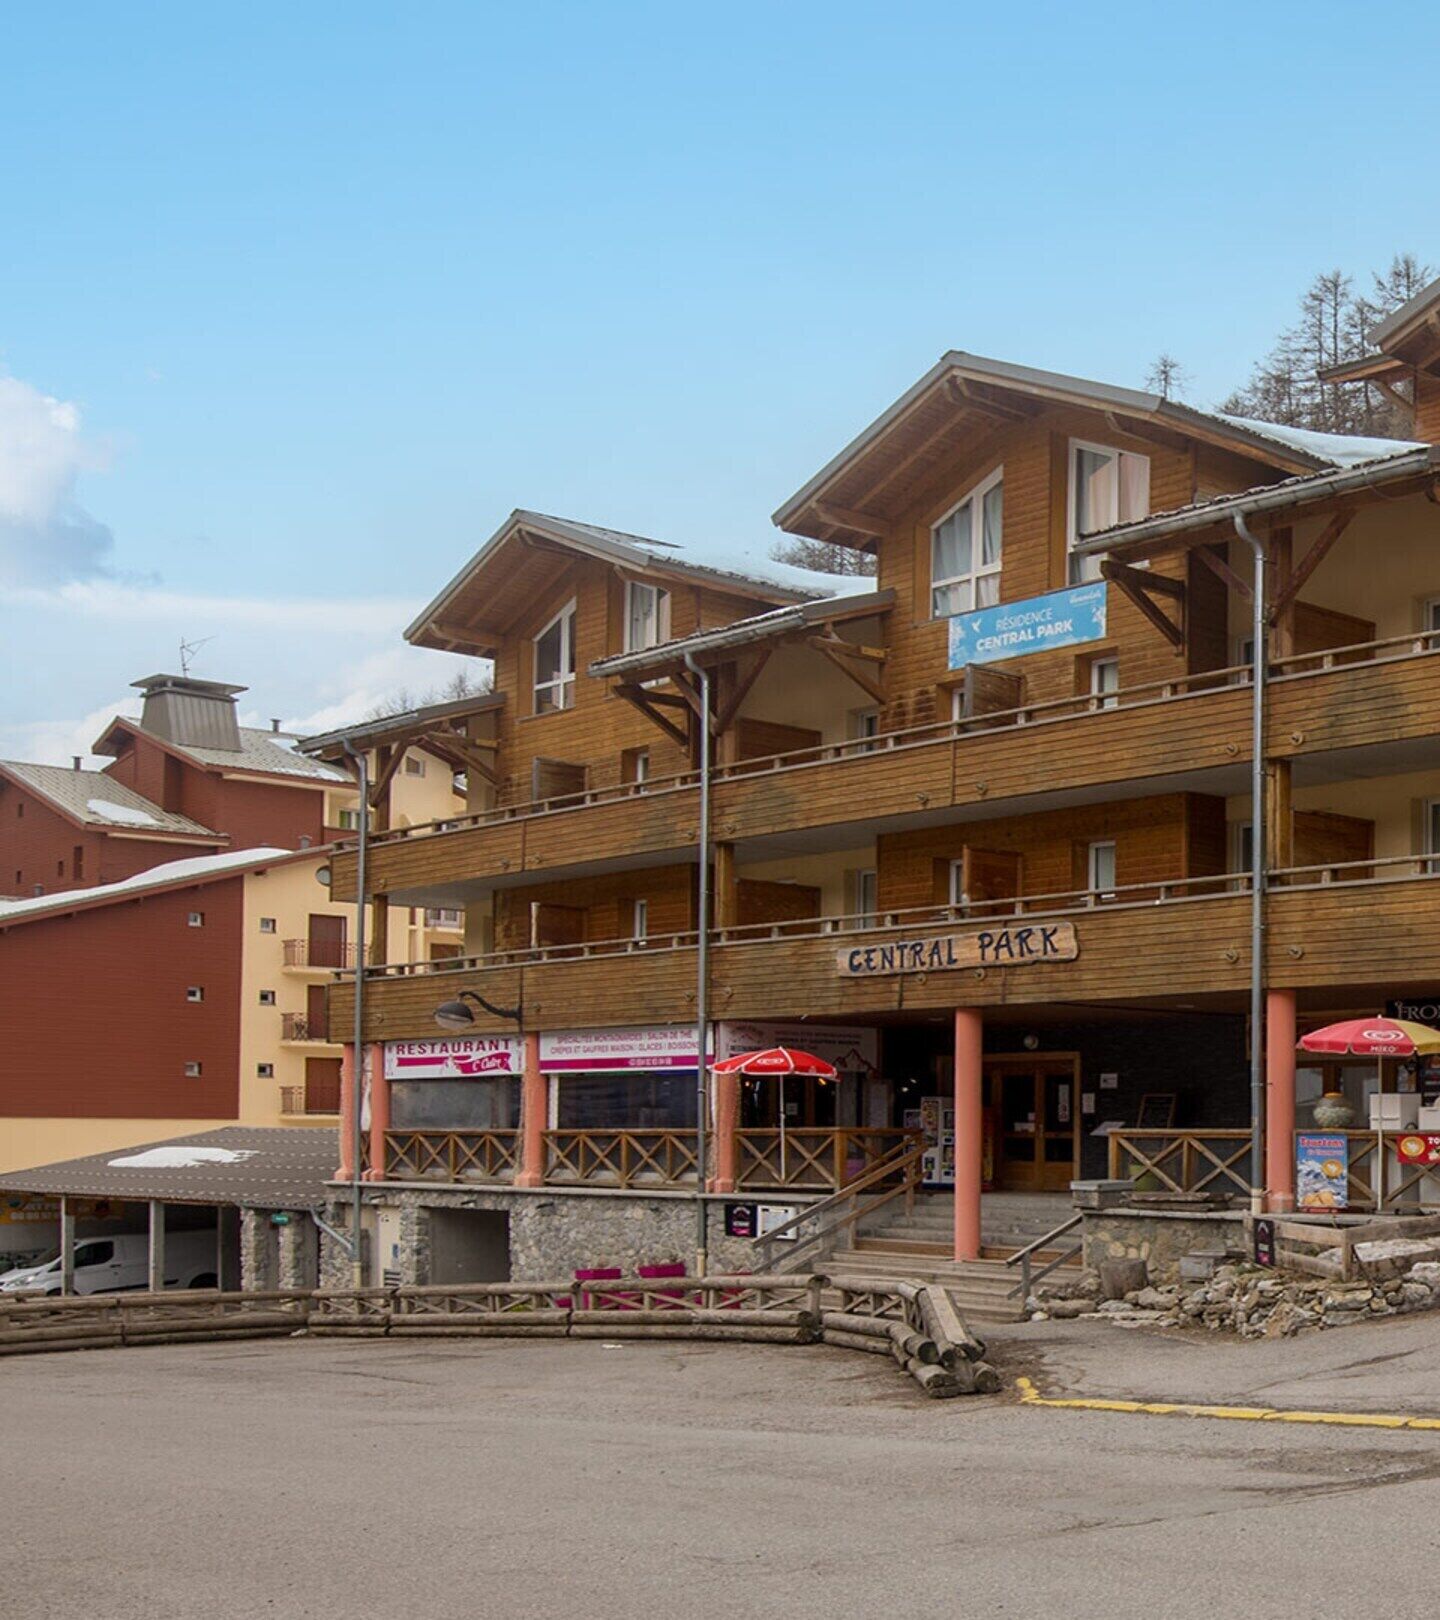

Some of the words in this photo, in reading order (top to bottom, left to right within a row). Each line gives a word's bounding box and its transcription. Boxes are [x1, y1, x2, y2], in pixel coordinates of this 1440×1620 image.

[996, 608, 1053, 631] RÉSIDENCE
[976, 629, 1034, 651] CENTRAL
[1037, 619, 1073, 638] PARK
[848, 939, 957, 972] CENTRAL
[978, 926, 1059, 960] PARK
[396, 1038, 511, 1055] RESTAURANT
[1370, 1045, 1396, 1053] MIKO
